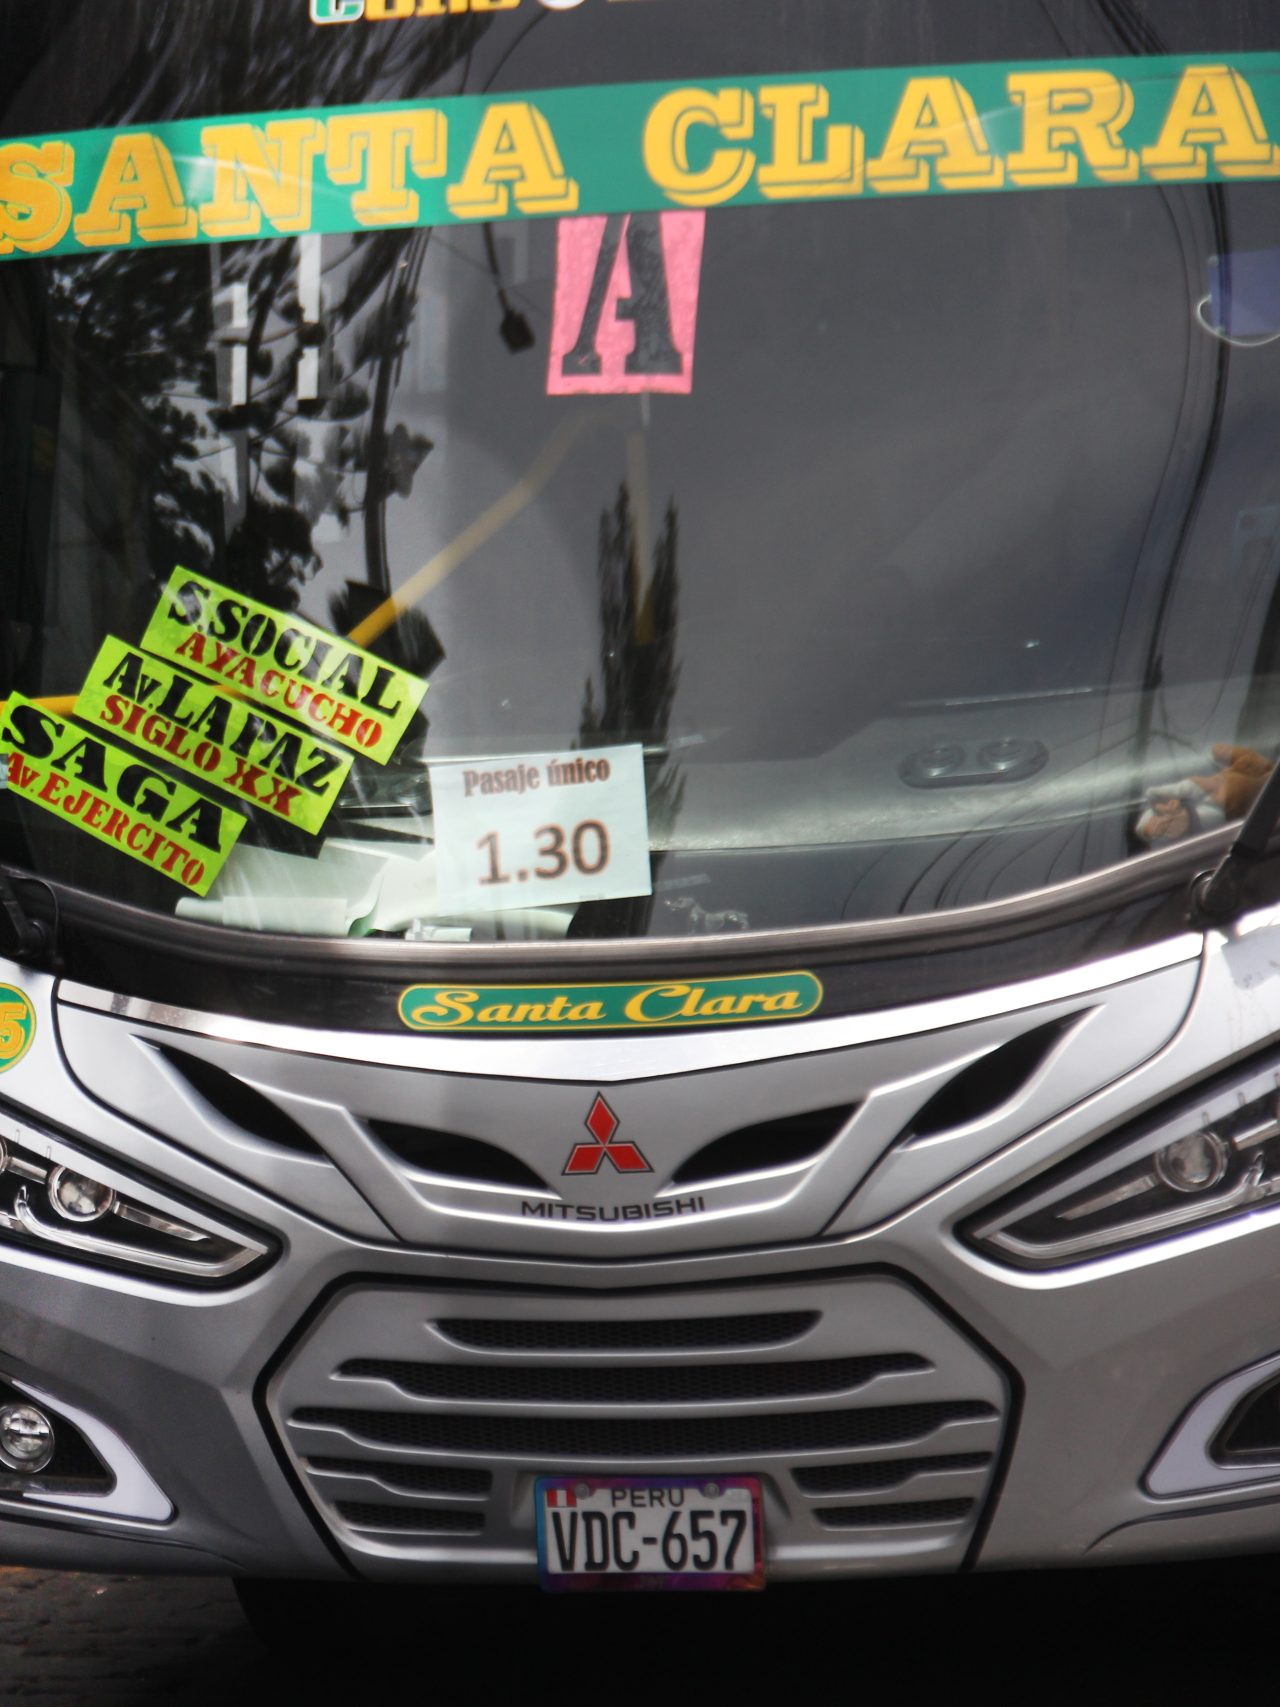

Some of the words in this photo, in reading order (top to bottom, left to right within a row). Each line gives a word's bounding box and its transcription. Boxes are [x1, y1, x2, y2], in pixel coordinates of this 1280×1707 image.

[642, 64, 1280, 208] CLARA
[561, 211, 684, 376] A
[175, 632, 383, 748] AYACUCHO
[1, 704, 222, 854] SAGA
[100, 694, 221, 772] SIGLO
[224, 757, 302, 816] XX
[462, 763, 541, 797] Pasaje
[546, 757, 611, 787] único
[37, 772, 205, 886] EJERCITO
[477, 818, 611, 886] 1.30
[411, 990, 607, 1026] Santa
[624, 984, 803, 1022] Clara
[521, 1196, 705, 1222] MITSUBISHI
[552, 1510, 748, 1571] VDC-657
[611, 1487, 685, 1508] PERU
